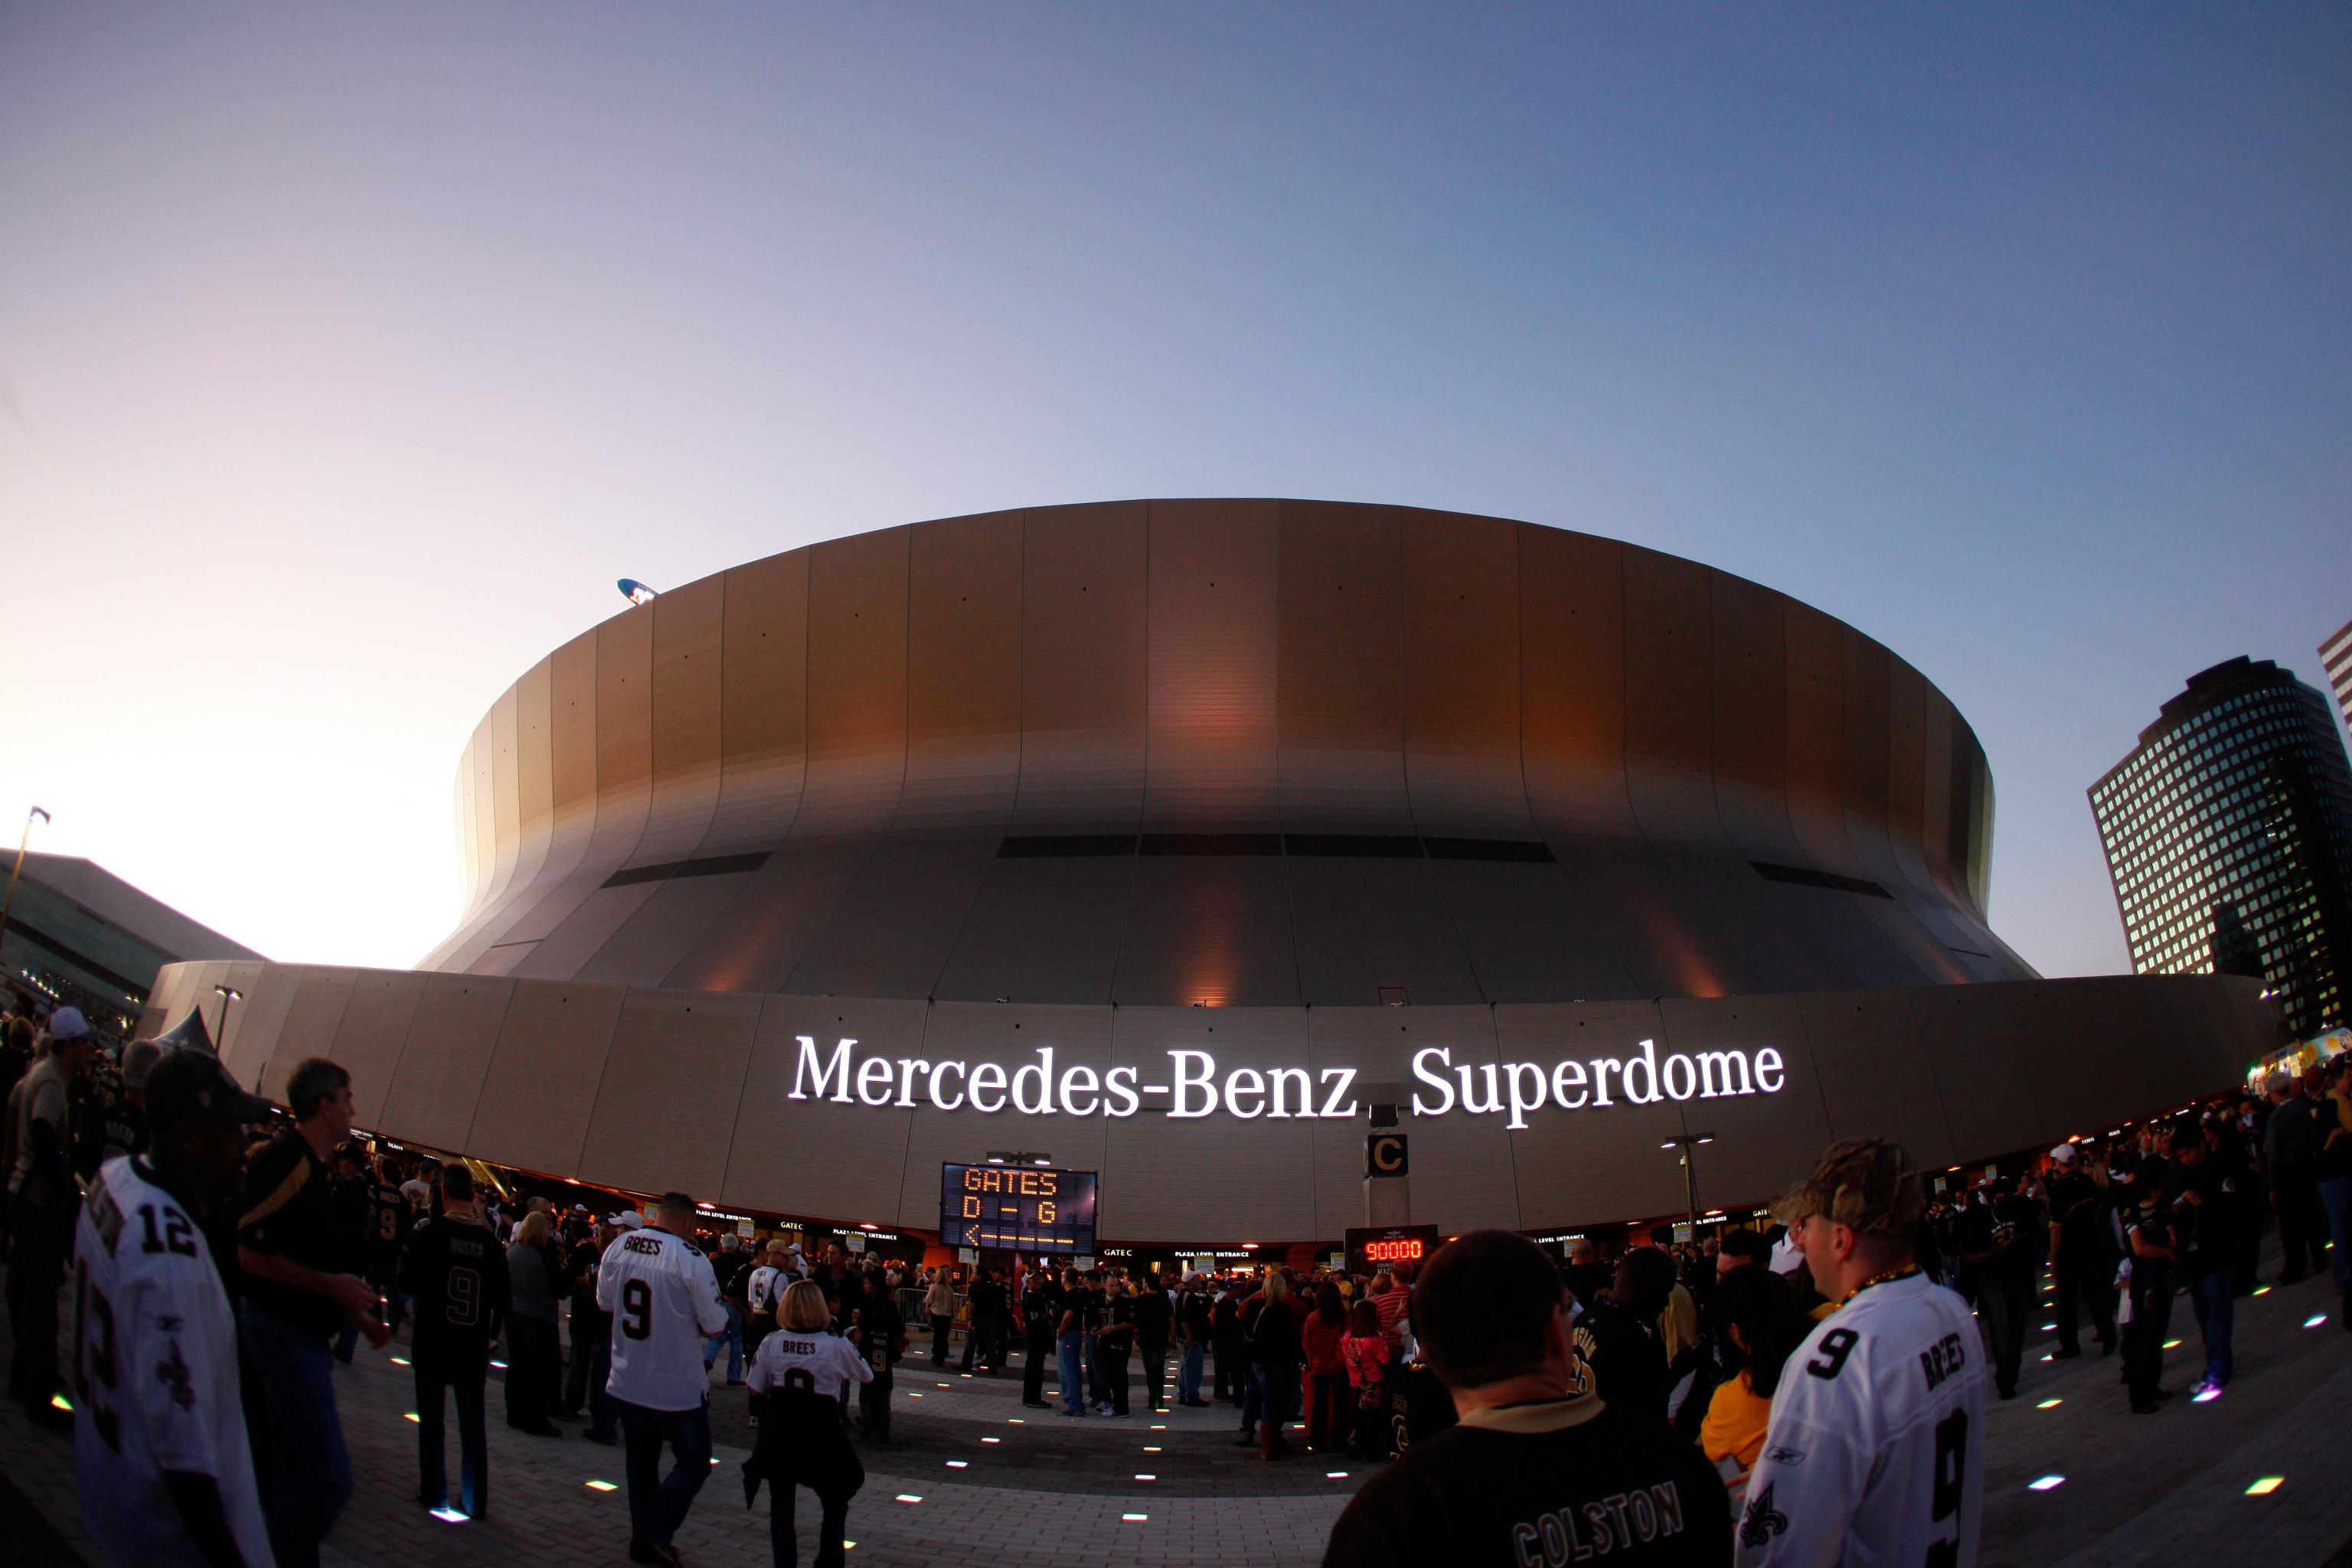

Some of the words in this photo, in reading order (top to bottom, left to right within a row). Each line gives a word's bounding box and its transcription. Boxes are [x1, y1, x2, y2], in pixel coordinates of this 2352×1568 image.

[788, 1036, 1357, 1119] Mercedes-Benz
[1412, 1039, 1785, 1129] Superdome
[1374, 1138, 1403, 1171] C
[964, 1168, 1058, 1196] GATES
[380, 1208, 397, 1240] 9
[962, 1195, 981, 1219] D
[1037, 1201, 1056, 1223] G
[139, 1204, 197, 1258] 12
[780, 1221, 798, 1230] GATE
[1556, 1233, 1585, 1242] ENTRANCE
[624, 1235, 662, 1256] BREES
[1365, 1240, 1423, 1261] 90000
[446, 1266, 481, 1327] 9
[622, 1278, 651, 1341] 9
[782, 1340, 816, 1355] BREES
[871, 1349, 887, 1372] 9
[1807, 1328, 1859, 1380] 9
[1511, 1479, 1684, 1568] COLSTON
